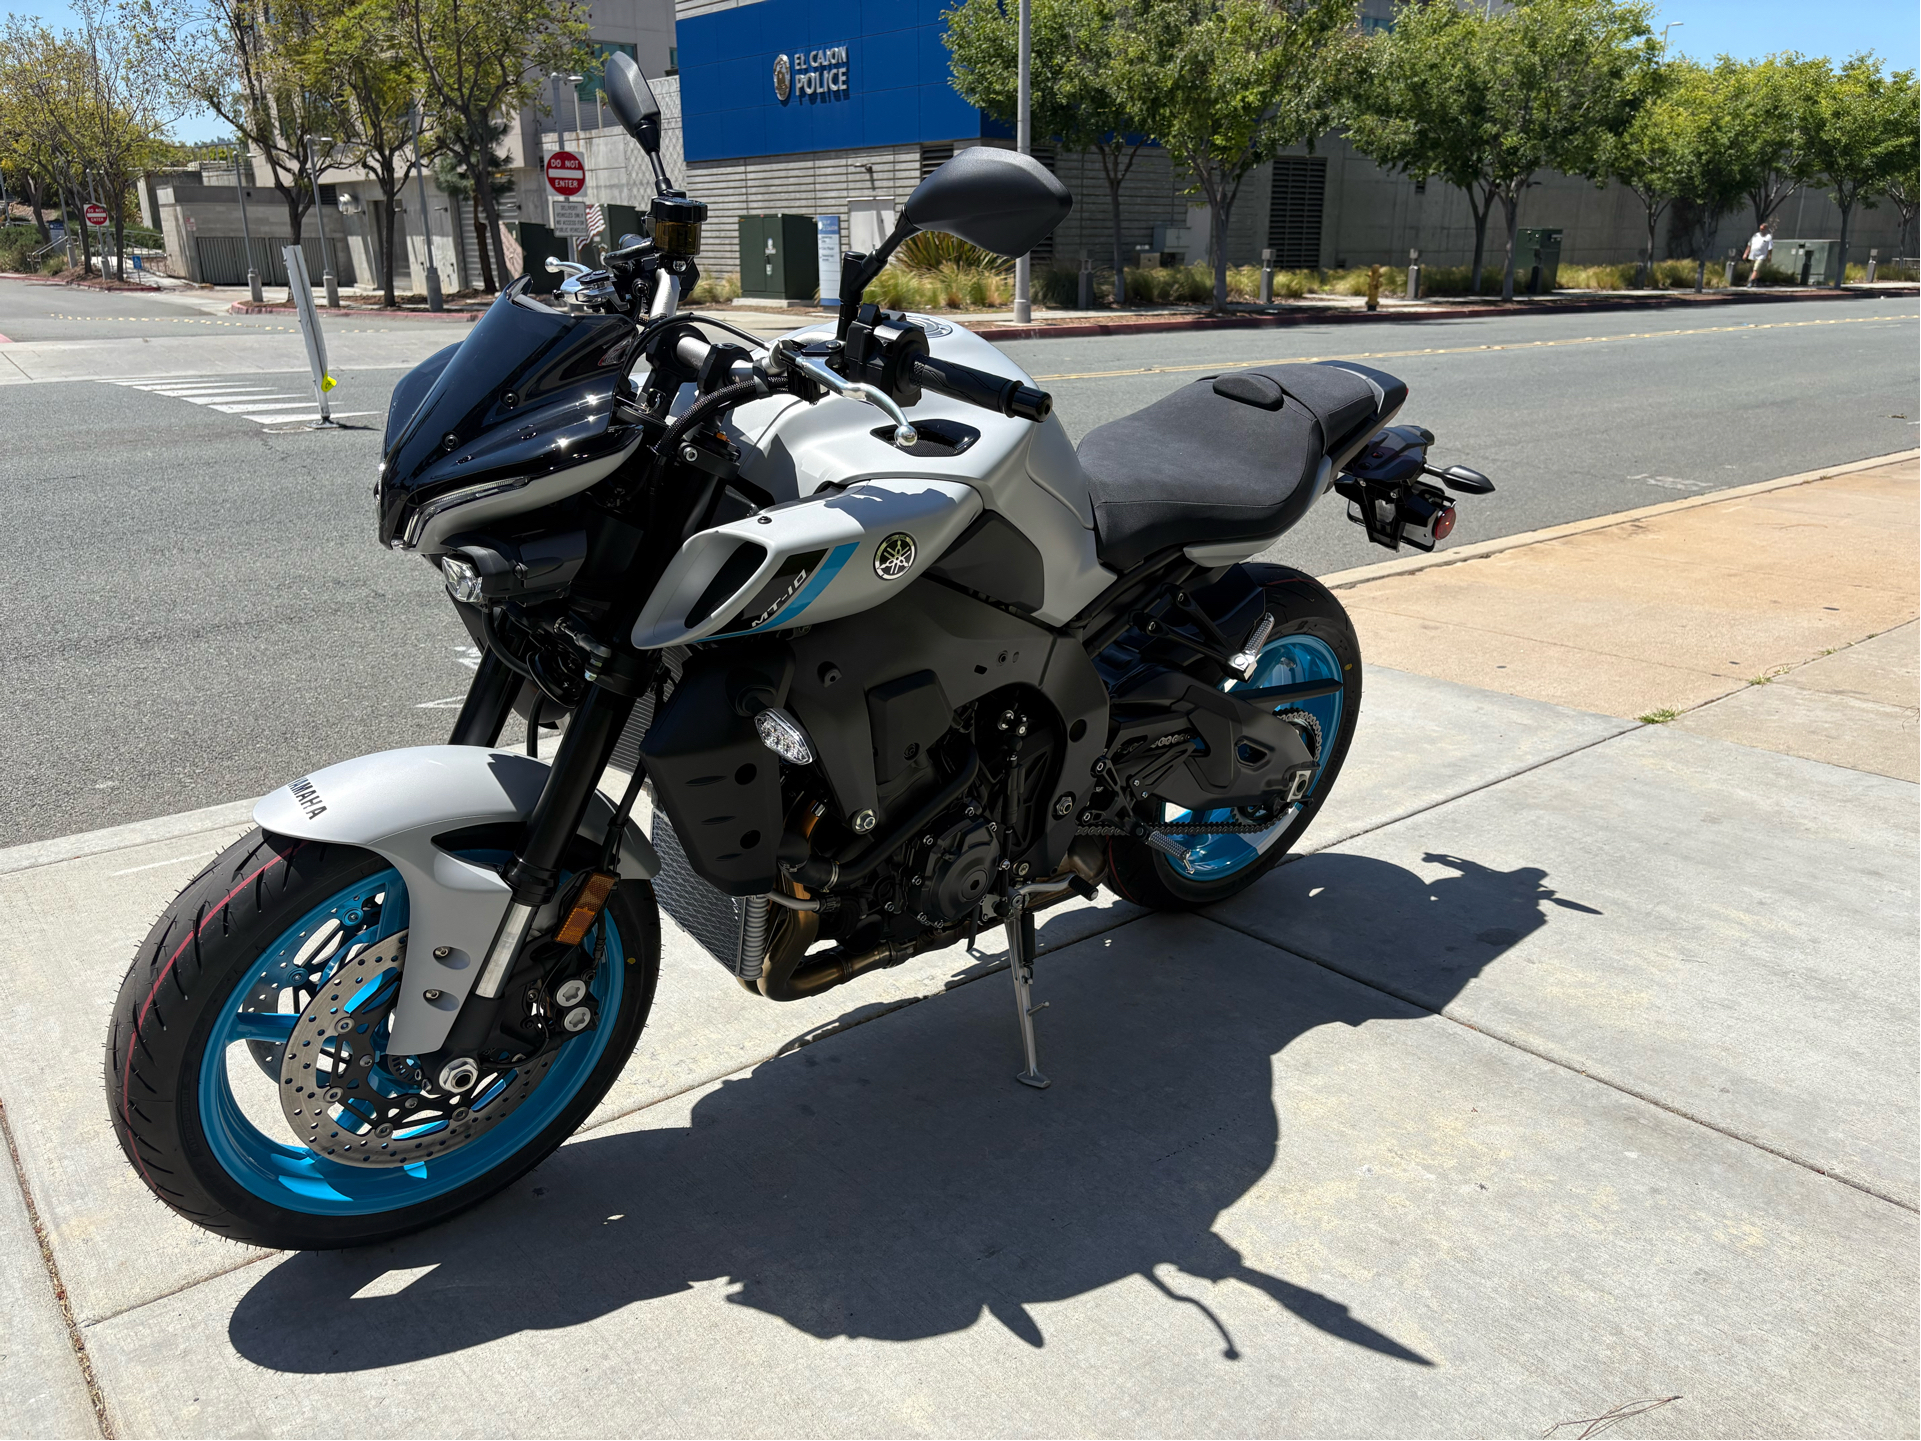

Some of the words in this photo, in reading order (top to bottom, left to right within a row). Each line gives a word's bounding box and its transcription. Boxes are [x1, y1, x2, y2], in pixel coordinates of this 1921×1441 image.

[794, 53, 807, 70] EL
[809, 46, 847, 67] CAJON
[795, 67, 847, 96] POLICE
[551, 159, 561, 168] DO
[565, 160, 579, 168] NOT
[555, 180, 578, 188] ENTER
[751, 568, 807, 628] MT-10
[287, 776, 327, 820] YAMAHA
